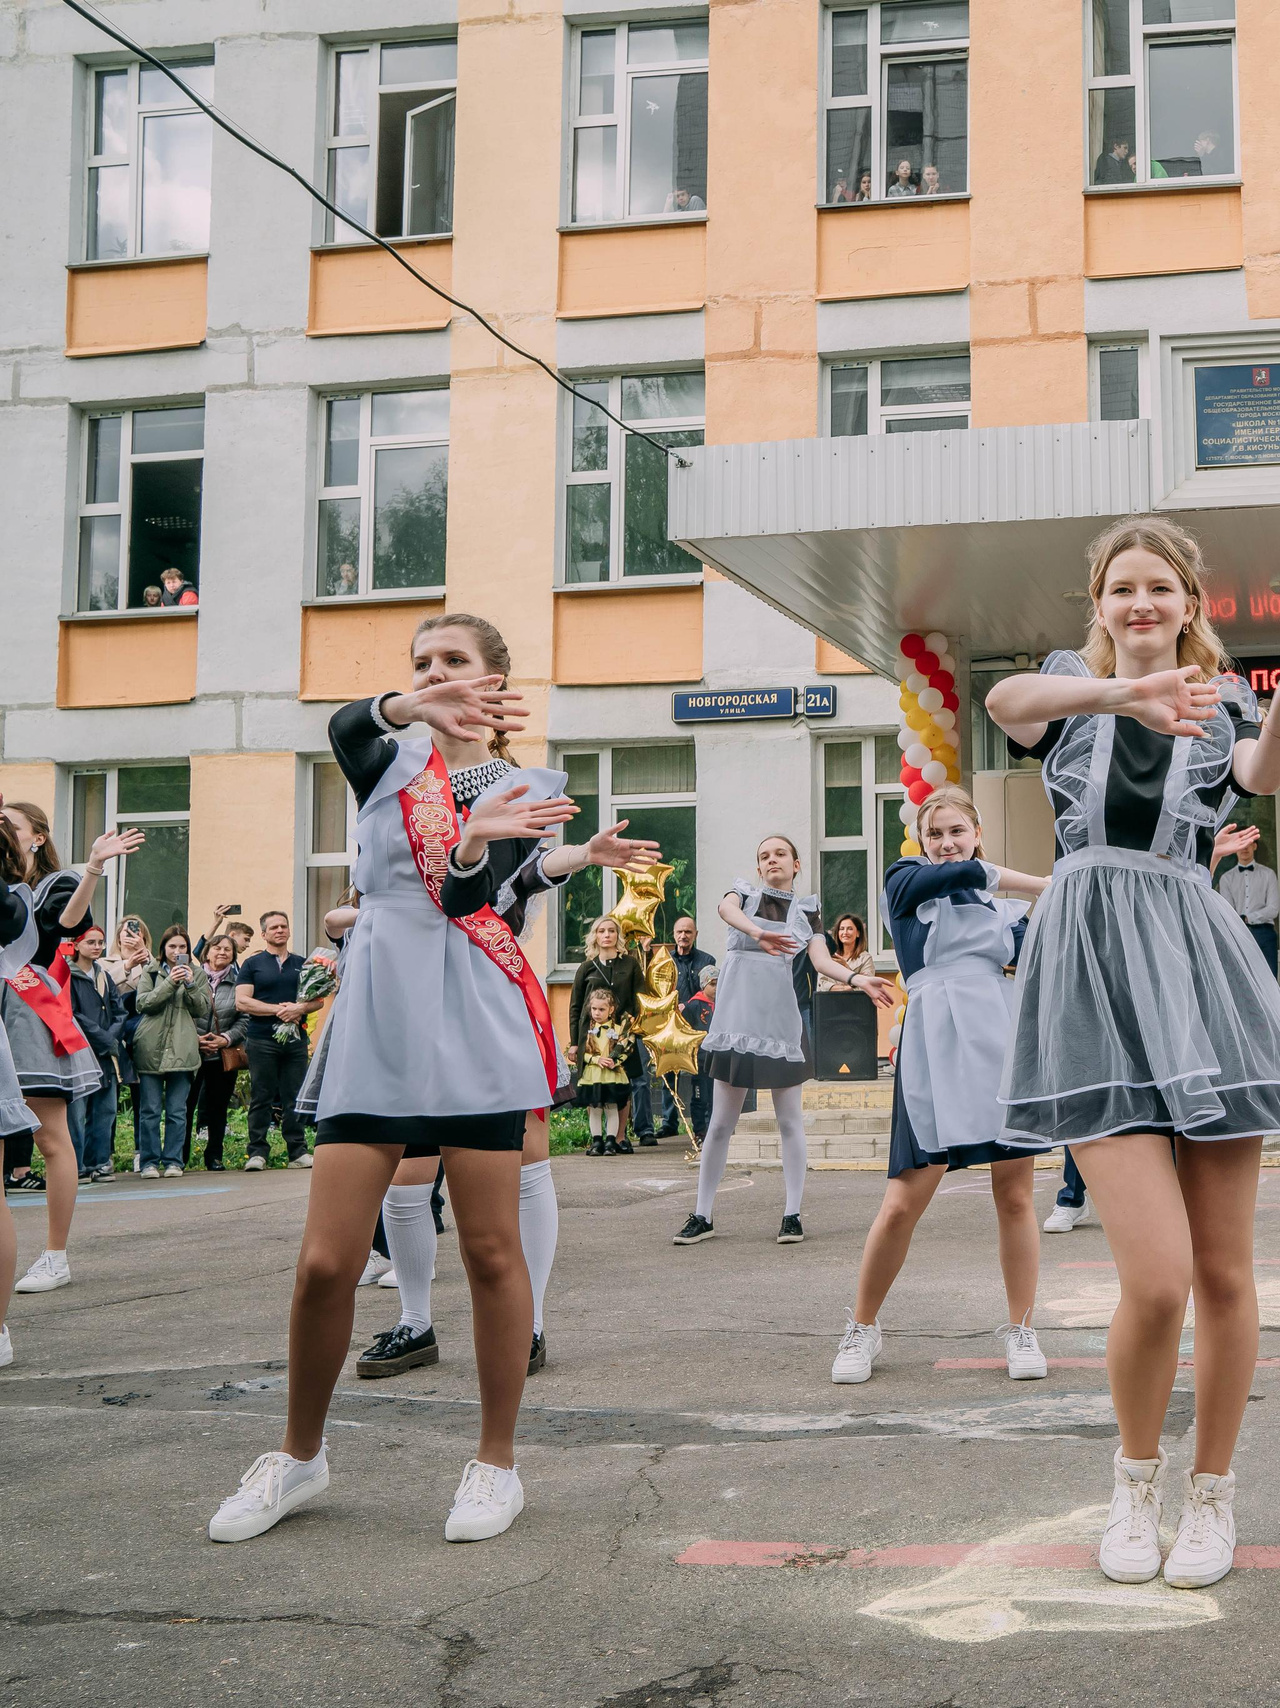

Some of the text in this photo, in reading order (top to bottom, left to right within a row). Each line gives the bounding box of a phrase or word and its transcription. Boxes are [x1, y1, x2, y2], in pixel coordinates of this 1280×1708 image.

[1203, 405, 1280, 413] ОБЩЕОБРАЗОВАТЕЛЬНОЕ
[1232, 419, 1266, 428] «ШКОЛА
[688, 694, 829, 707] НОВГОРОДСКАЯ 21А
[719, 707, 746, 715] УЛИЦА
